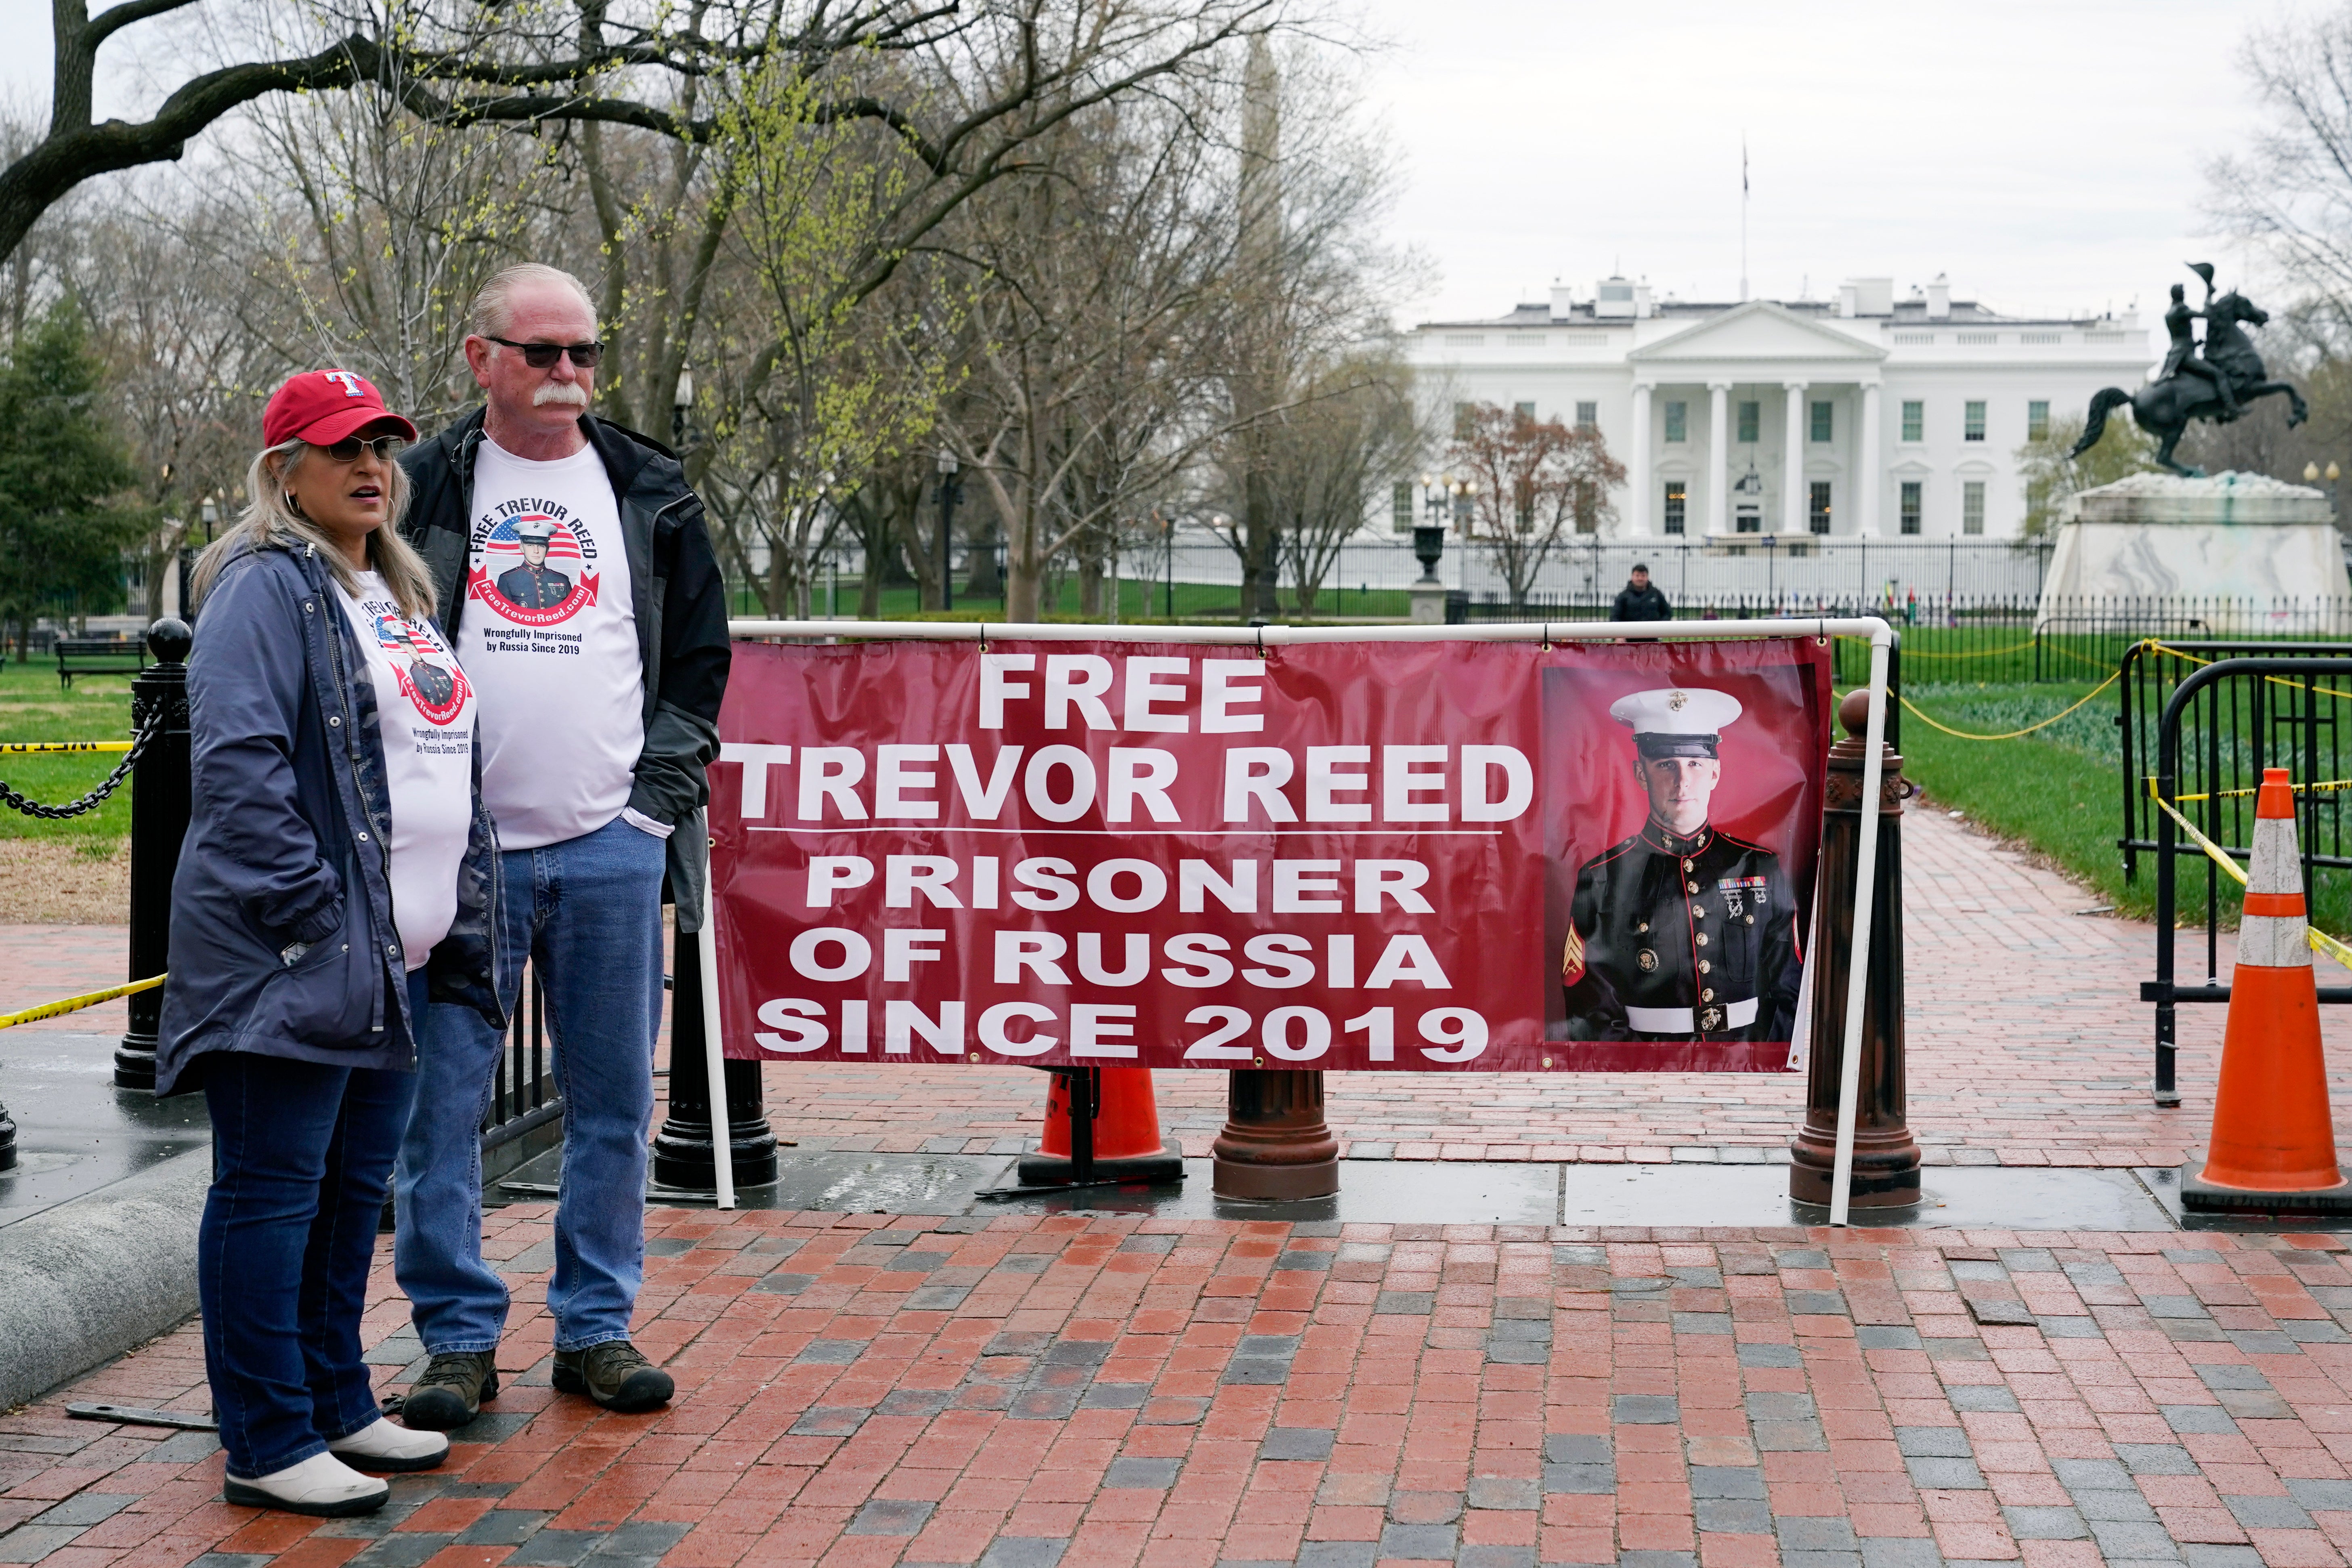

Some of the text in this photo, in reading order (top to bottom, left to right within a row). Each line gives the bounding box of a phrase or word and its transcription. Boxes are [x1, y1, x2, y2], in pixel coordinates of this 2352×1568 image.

[324, 371, 365, 397] T
[469, 498, 598, 559] FREE TREVOR REED
[480, 582, 585, 623] FreeTrevorReed.com
[409, 618, 444, 652] REED
[483, 628, 582, 642] Wrongfully Imprisoned
[487, 642, 579, 655] by Russia Since 2019
[406, 678, 463, 721] FreeTrevorReed.com
[978, 653, 1266, 734] FREE
[412, 727, 468, 741] Wrongfully Imprisoned
[416, 742, 469, 754] by Russia Since 2019
[719, 743, 1534, 823] TREVOR REED
[806, 854, 1436, 914] PRISONER
[789, 927, 1453, 989] OF RUSSIA
[753, 997, 1489, 1062] SINCE 2019
